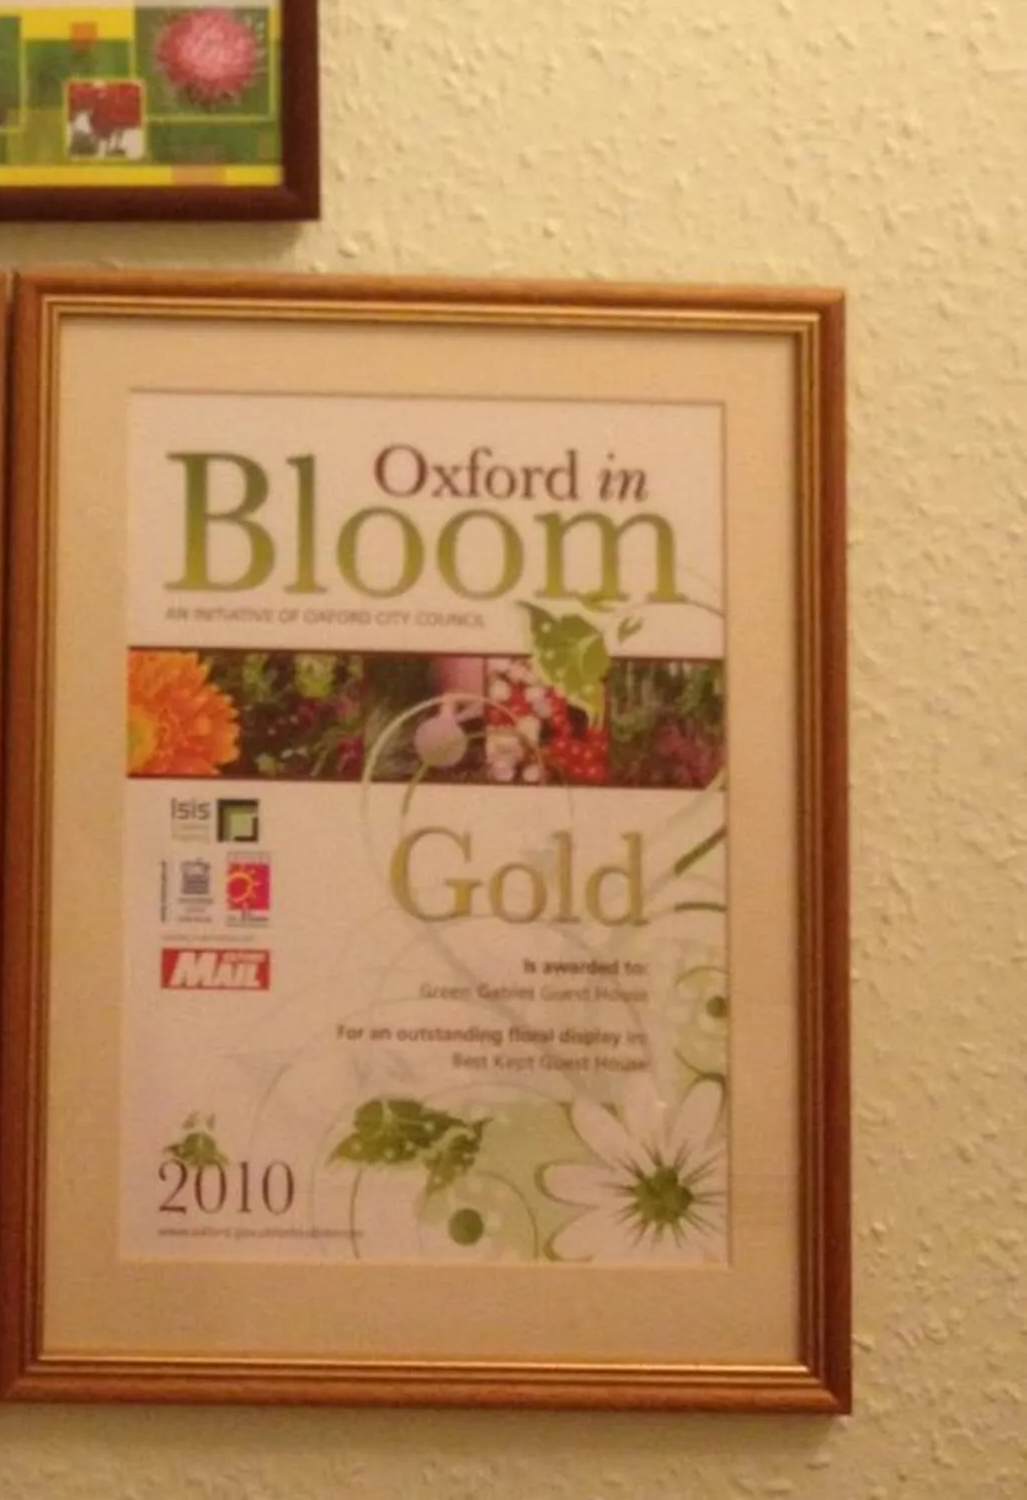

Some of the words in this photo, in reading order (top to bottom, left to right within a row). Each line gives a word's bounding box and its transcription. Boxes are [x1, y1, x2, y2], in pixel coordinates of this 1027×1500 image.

[374, 444, 580, 501] Oxford
[597, 453, 649, 503] in
[164, 452, 687, 603] Bloom
[389, 826, 650, 928] Gold
[171, 951, 261, 987] MAIL
[542, 959, 619, 975] awarded
[337, 1025, 364, 1041] For
[369, 1028, 392, 1042] an
[396, 1026, 503, 1046] outstanding
[157, 1158, 295, 1216] 2010
